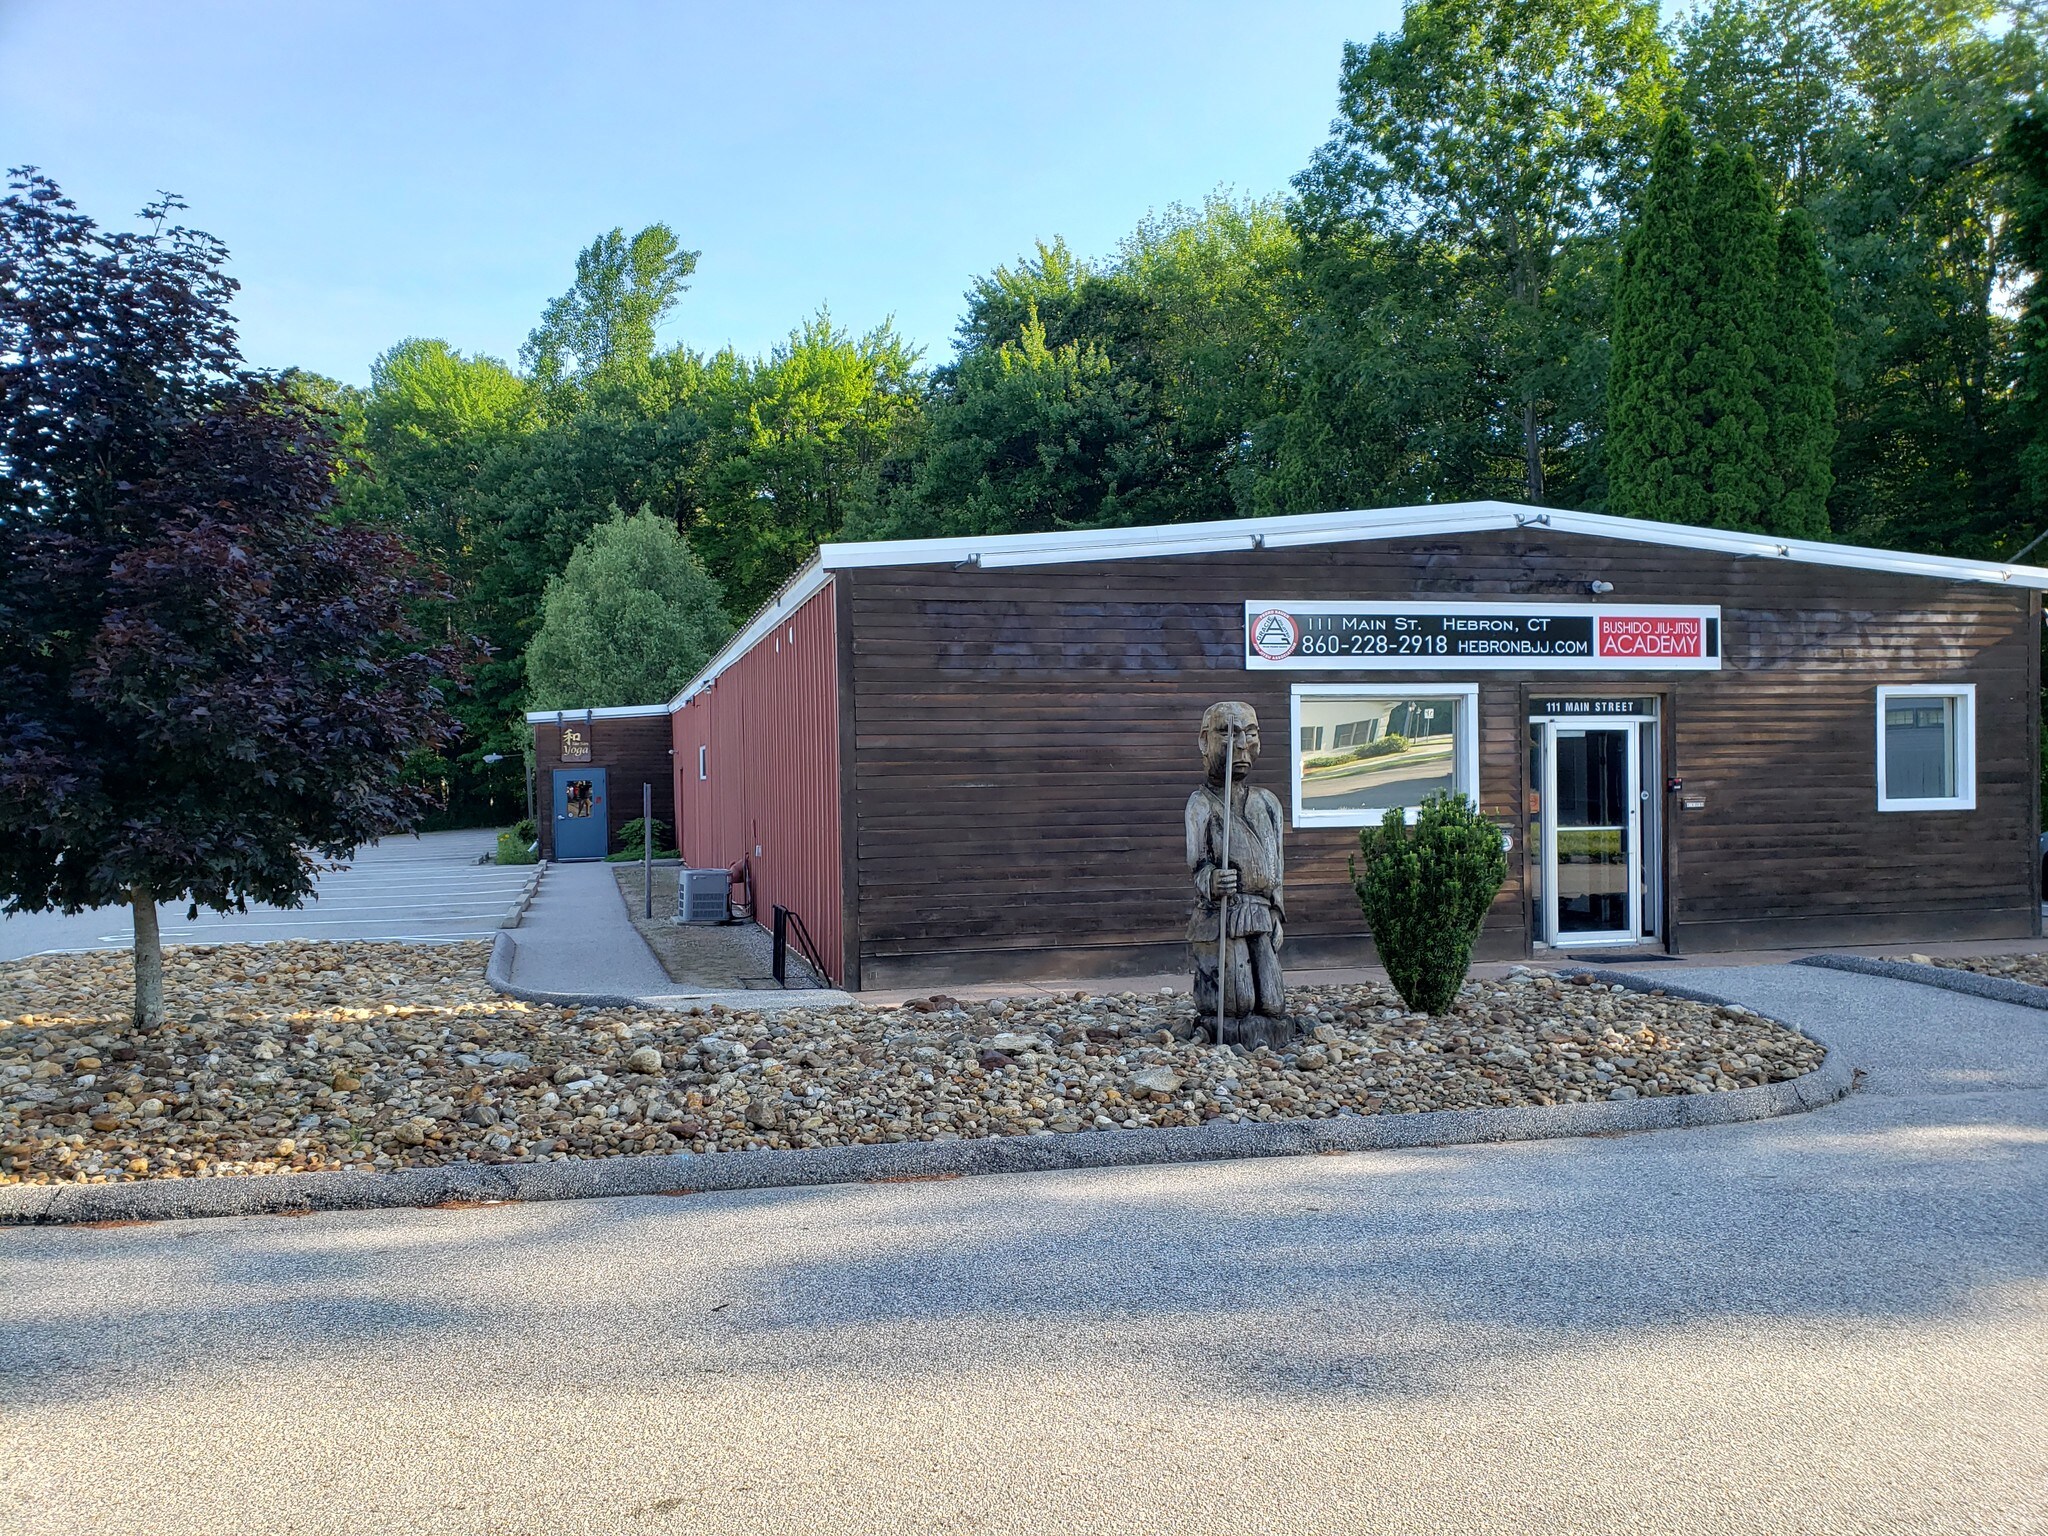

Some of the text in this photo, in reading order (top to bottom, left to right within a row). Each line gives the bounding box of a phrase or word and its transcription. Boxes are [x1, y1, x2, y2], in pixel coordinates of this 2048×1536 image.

[1256, 616, 1273, 641] GRACIE
[1342, 617, 1386, 630] MAIN
[1395, 617, 1422, 630] ST.
[1443, 618, 1519, 632] HEBRON,
[1527, 618, 1551, 631] CT
[1603, 621, 1698, 634] BUSHIDO JIU-JITSU
[1302, 635, 1588, 653] 860-228-2918 HEBRONBJJ.COM
[1603, 635, 1698, 653] ACADEMY
[1546, 702, 1634, 712] 111 MAIN STREET
[563, 728, 581, 745] 和
